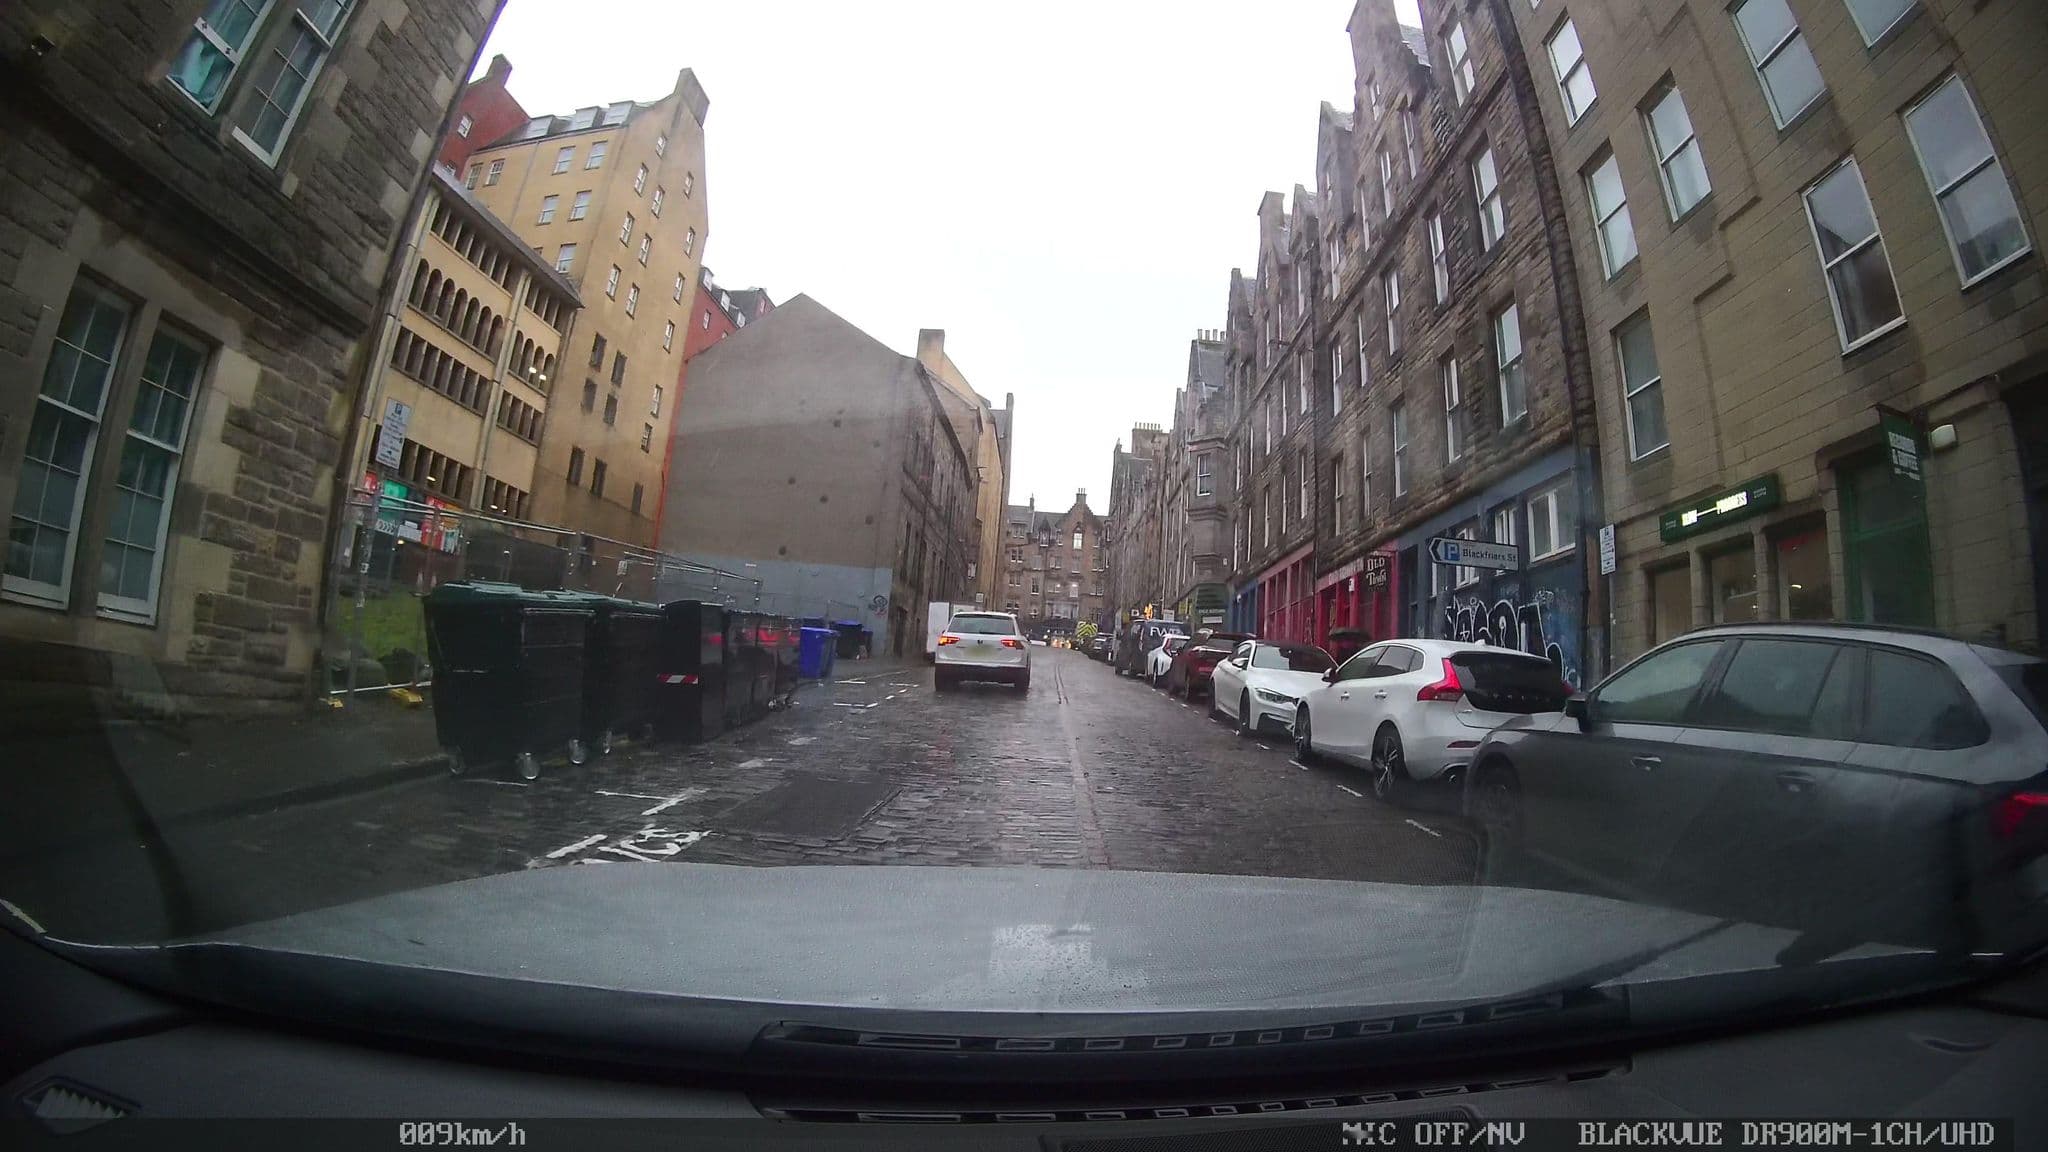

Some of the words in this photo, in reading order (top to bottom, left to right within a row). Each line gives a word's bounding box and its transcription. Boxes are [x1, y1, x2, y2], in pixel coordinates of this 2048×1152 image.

[1447, 544, 1458, 559] P
[1462, 548, 1505, 561] Blackfriars
[1507, 553, 1517, 562] St
[1367, 557, 1385, 571] OLD
